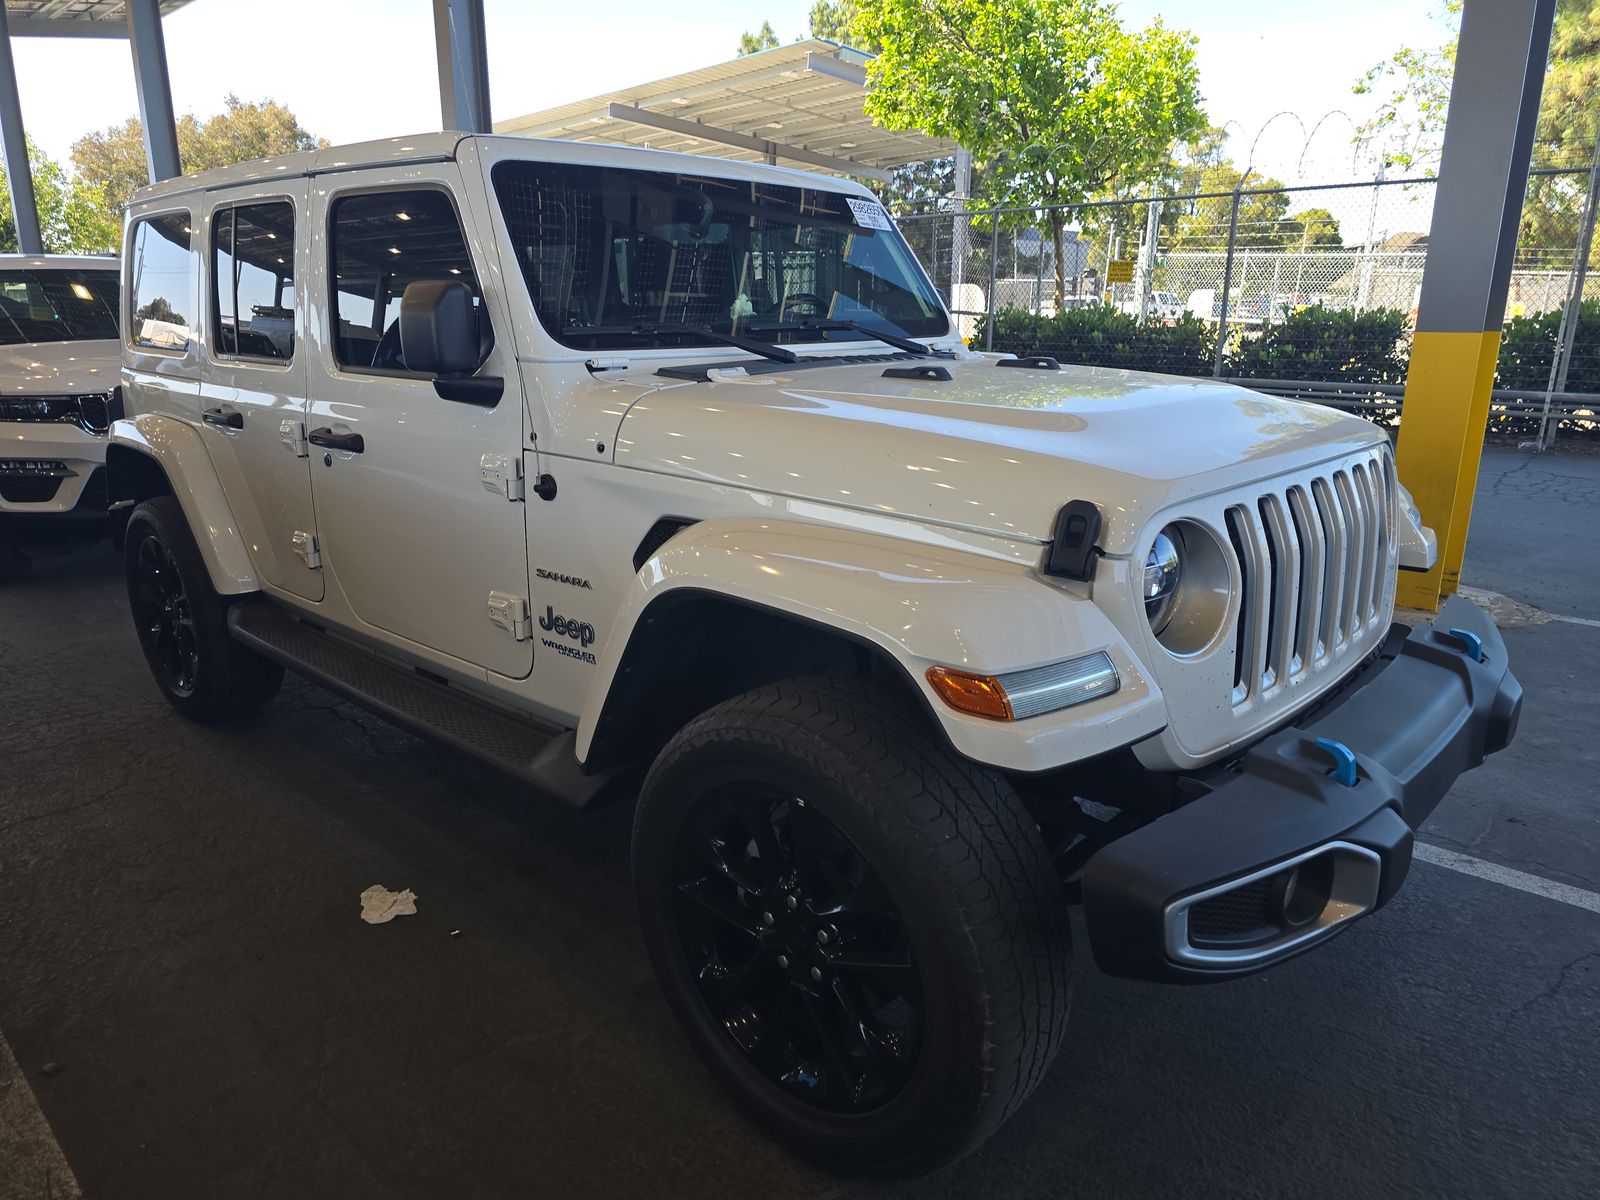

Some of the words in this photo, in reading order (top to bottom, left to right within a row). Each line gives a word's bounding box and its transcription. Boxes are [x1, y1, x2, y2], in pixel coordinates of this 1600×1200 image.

[536, 568, 593, 590] SAHARA
[538, 604, 595, 648] Jeep
[541, 637, 597, 661] WRANGLER
